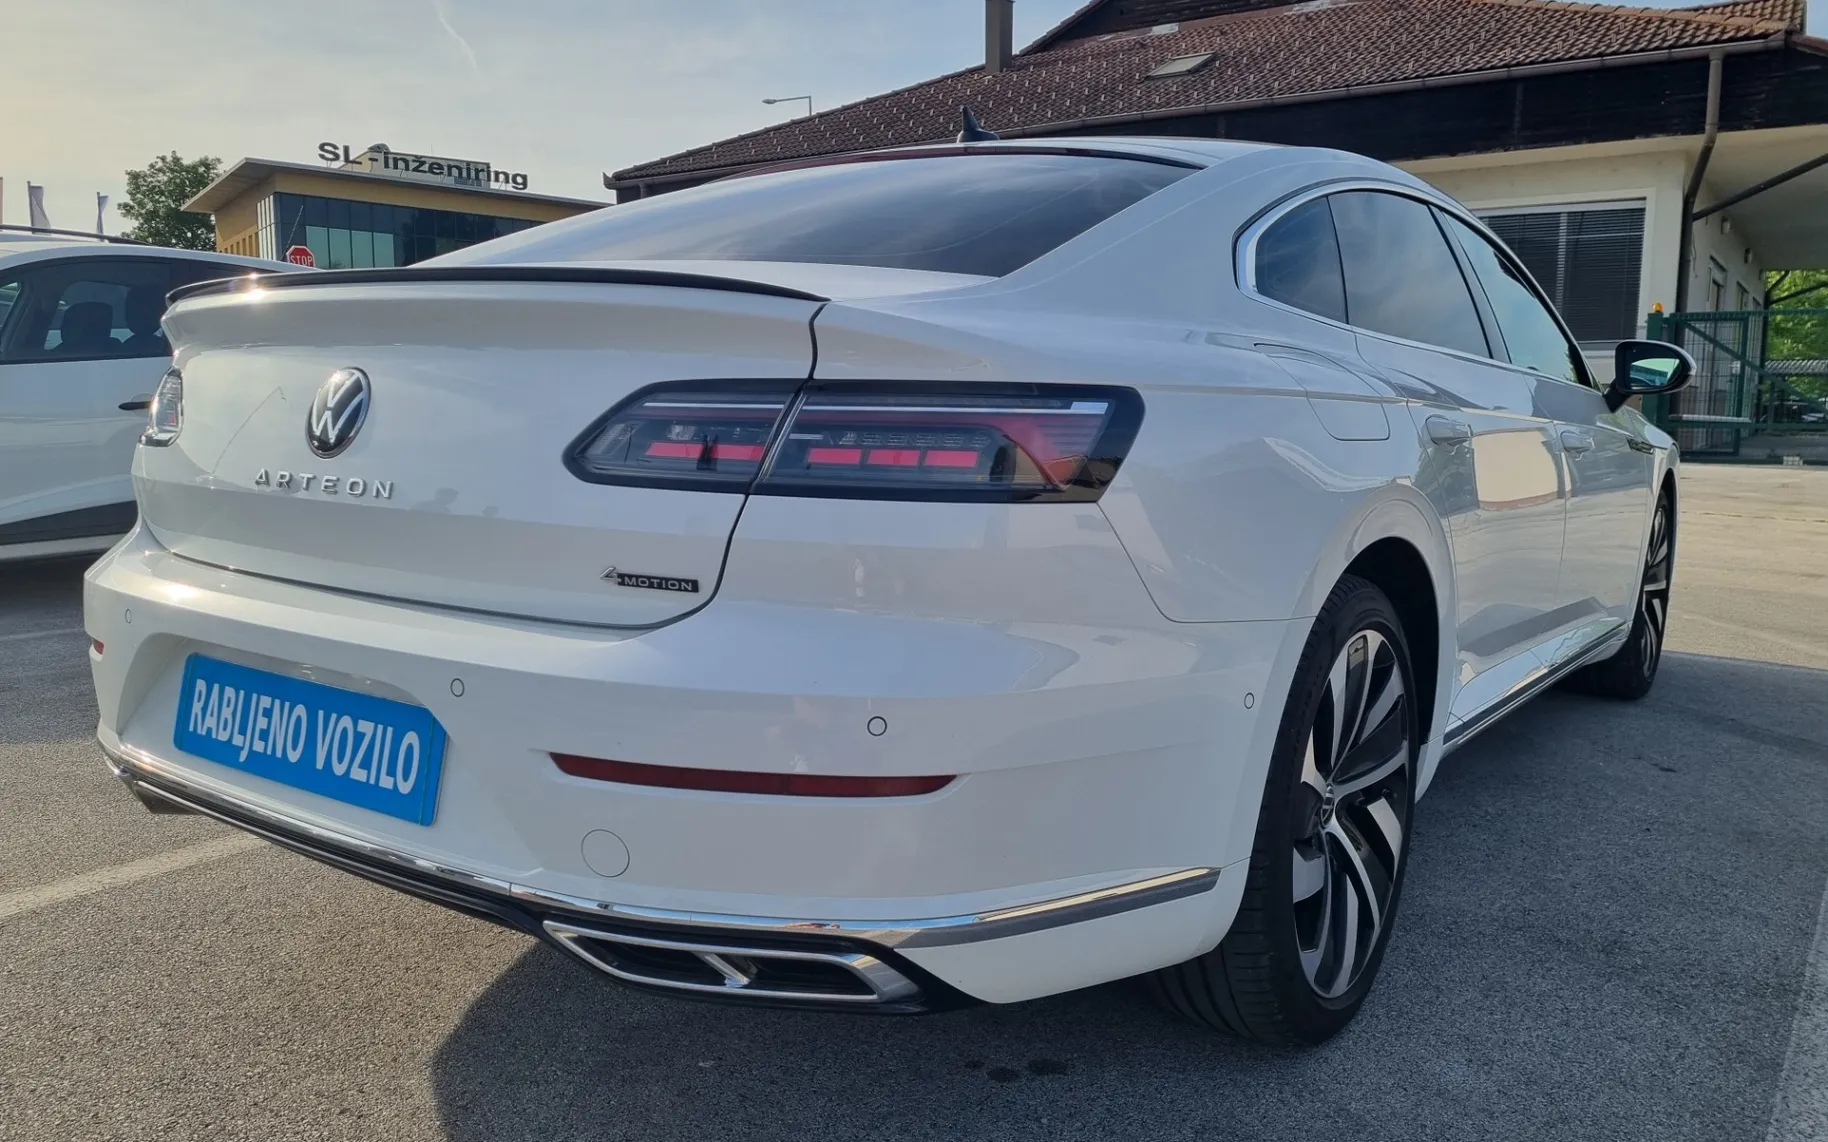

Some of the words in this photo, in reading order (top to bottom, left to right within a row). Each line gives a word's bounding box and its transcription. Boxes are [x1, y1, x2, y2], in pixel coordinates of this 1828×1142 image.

[290, 255, 313, 267] STOP
[255, 468, 393, 499] ARTEON
[189, 679, 307, 763] RABLJENO
[316, 710, 420, 794] VOZILO
